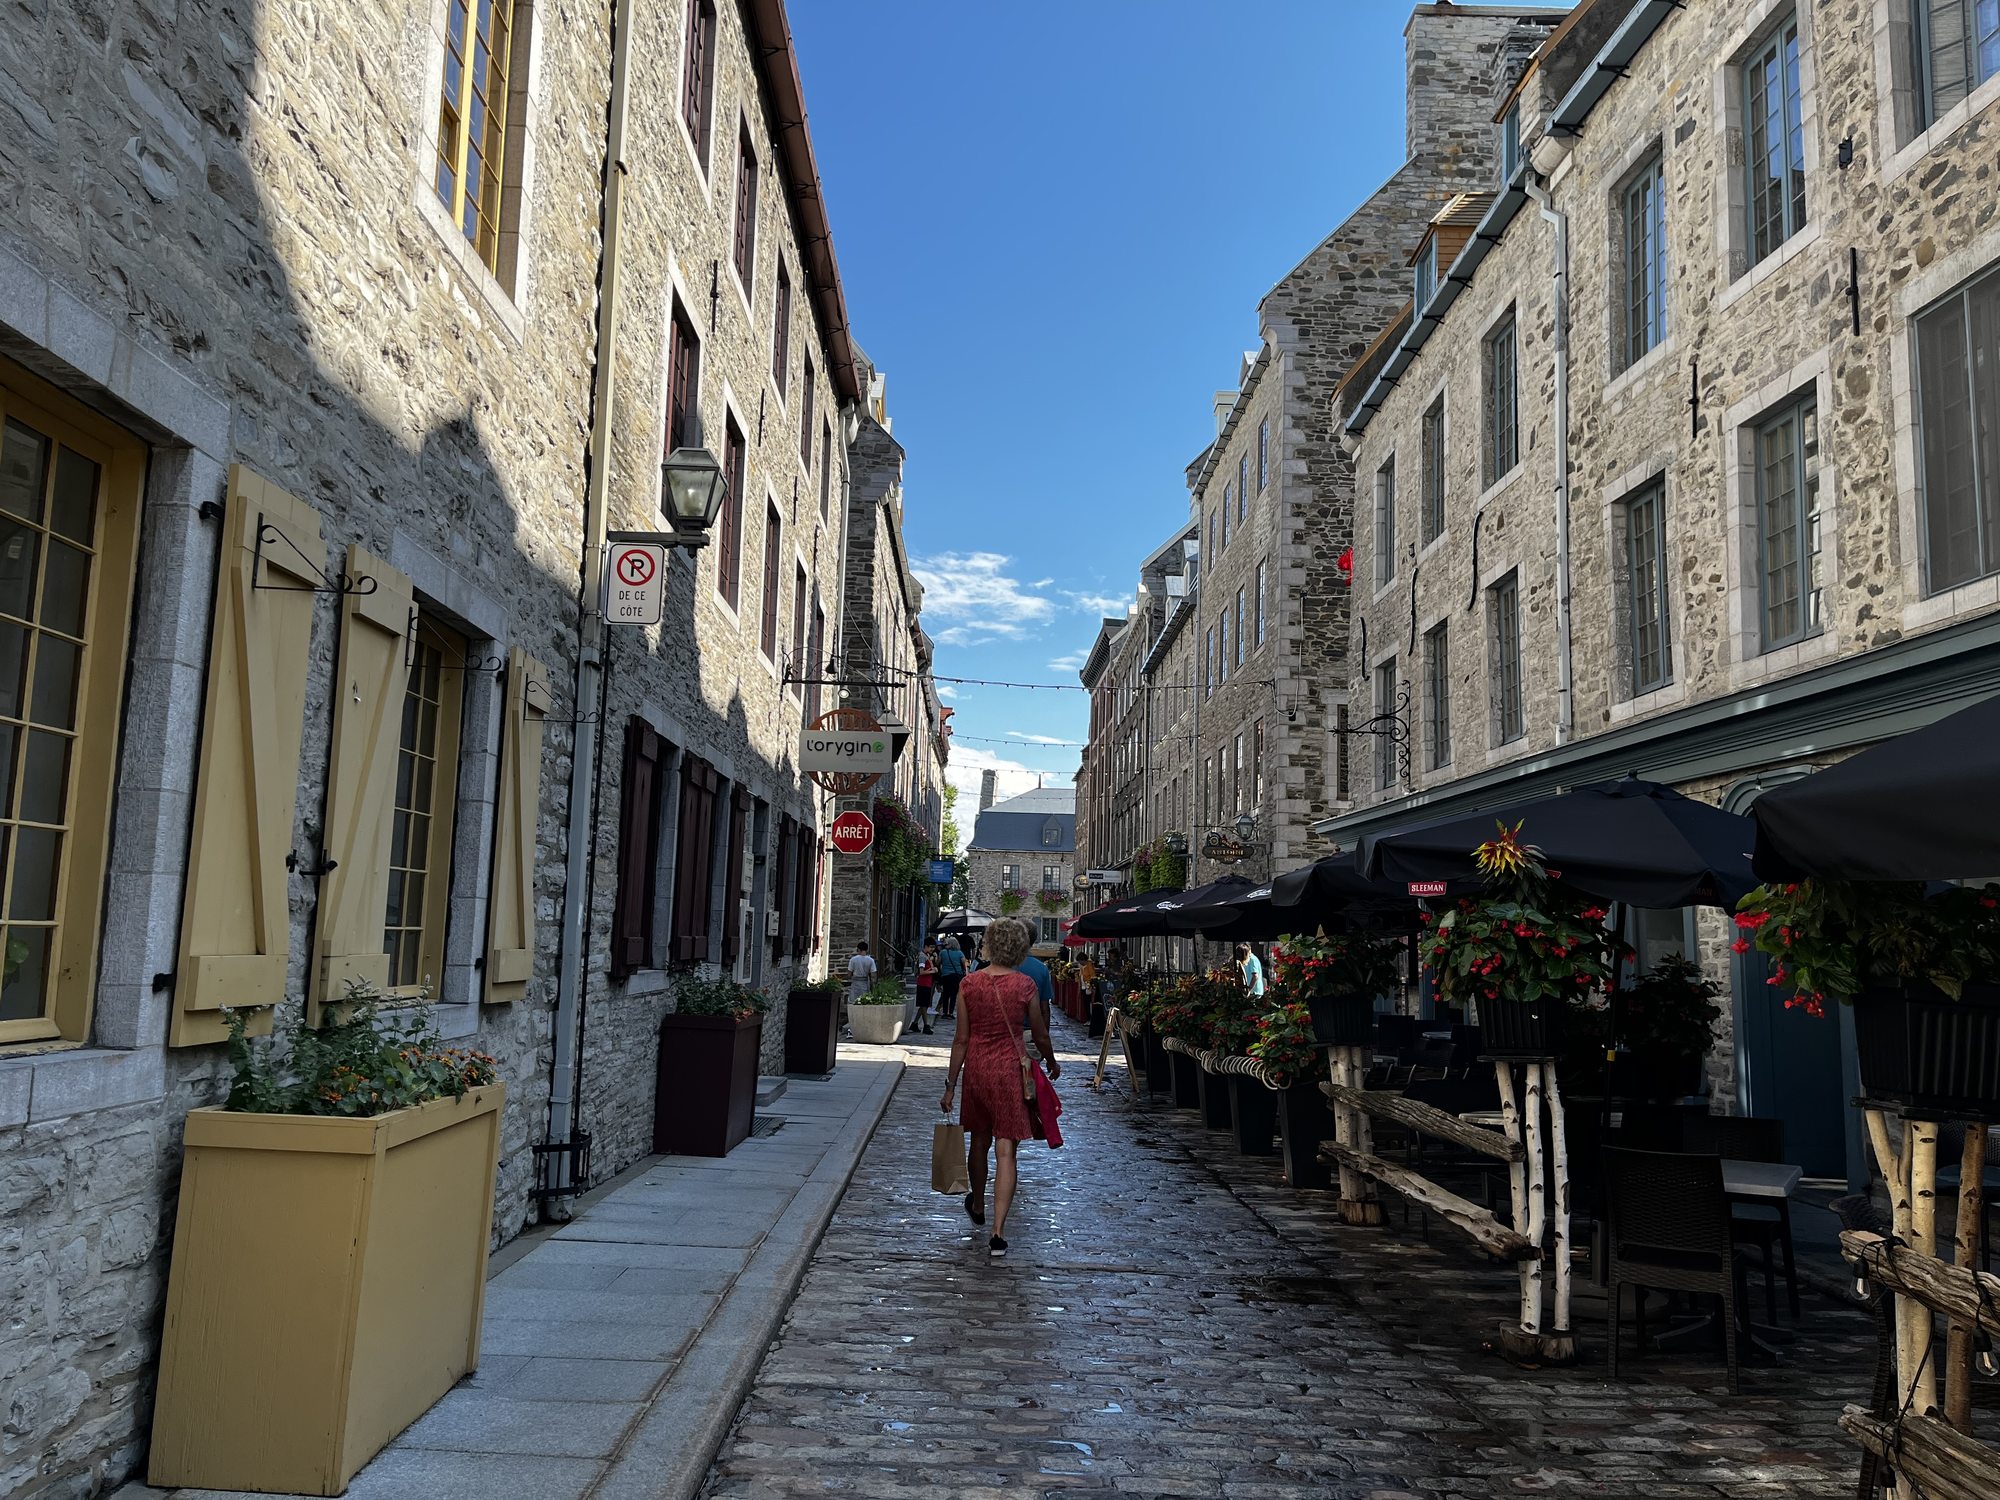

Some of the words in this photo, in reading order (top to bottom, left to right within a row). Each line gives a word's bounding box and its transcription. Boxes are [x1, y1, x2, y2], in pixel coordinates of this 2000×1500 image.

[619, 591, 630, 600] DE
[634, 591, 645, 600] CE
[620, 605, 643, 616] CÔTE
[835, 824, 869, 839] ARRÊT
[1411, 884, 1444, 892] SLEEMAN
